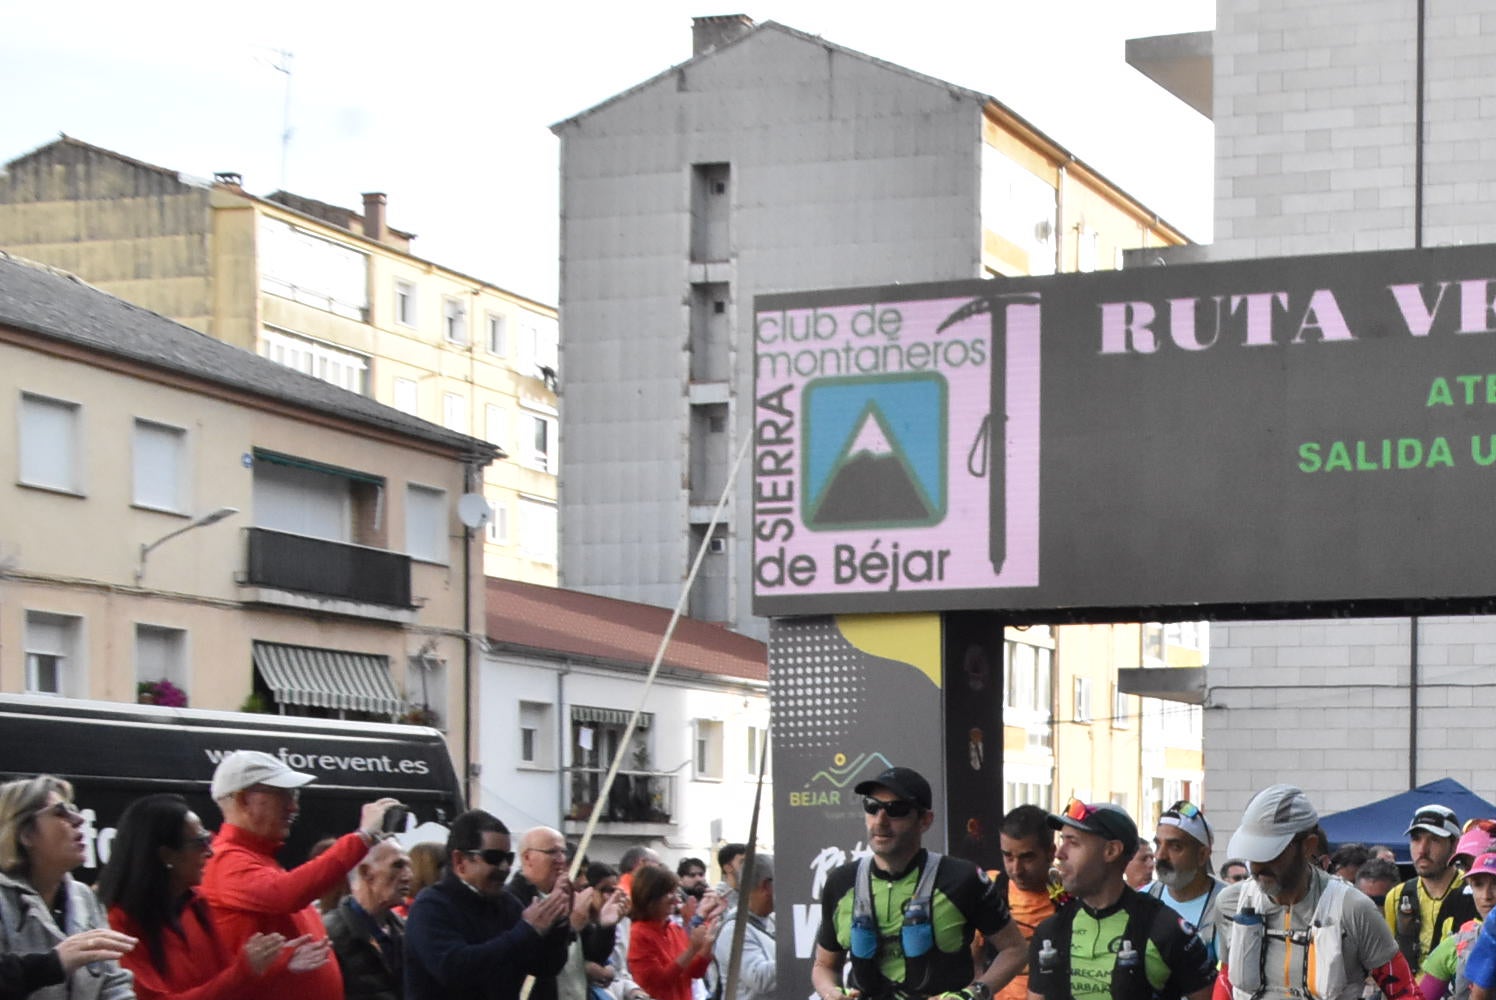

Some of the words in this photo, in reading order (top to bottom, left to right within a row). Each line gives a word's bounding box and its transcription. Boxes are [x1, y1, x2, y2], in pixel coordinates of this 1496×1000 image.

[757, 308, 838, 345] club
[851, 303, 903, 338] de
[1098, 288, 1359, 355] RUTA
[757, 337, 987, 379] montañeros
[756, 383, 795, 543] SIERRA
[1298, 436, 1455, 474] SALIDA
[756, 546, 817, 588] de
[834, 538, 951, 592] Béjar
